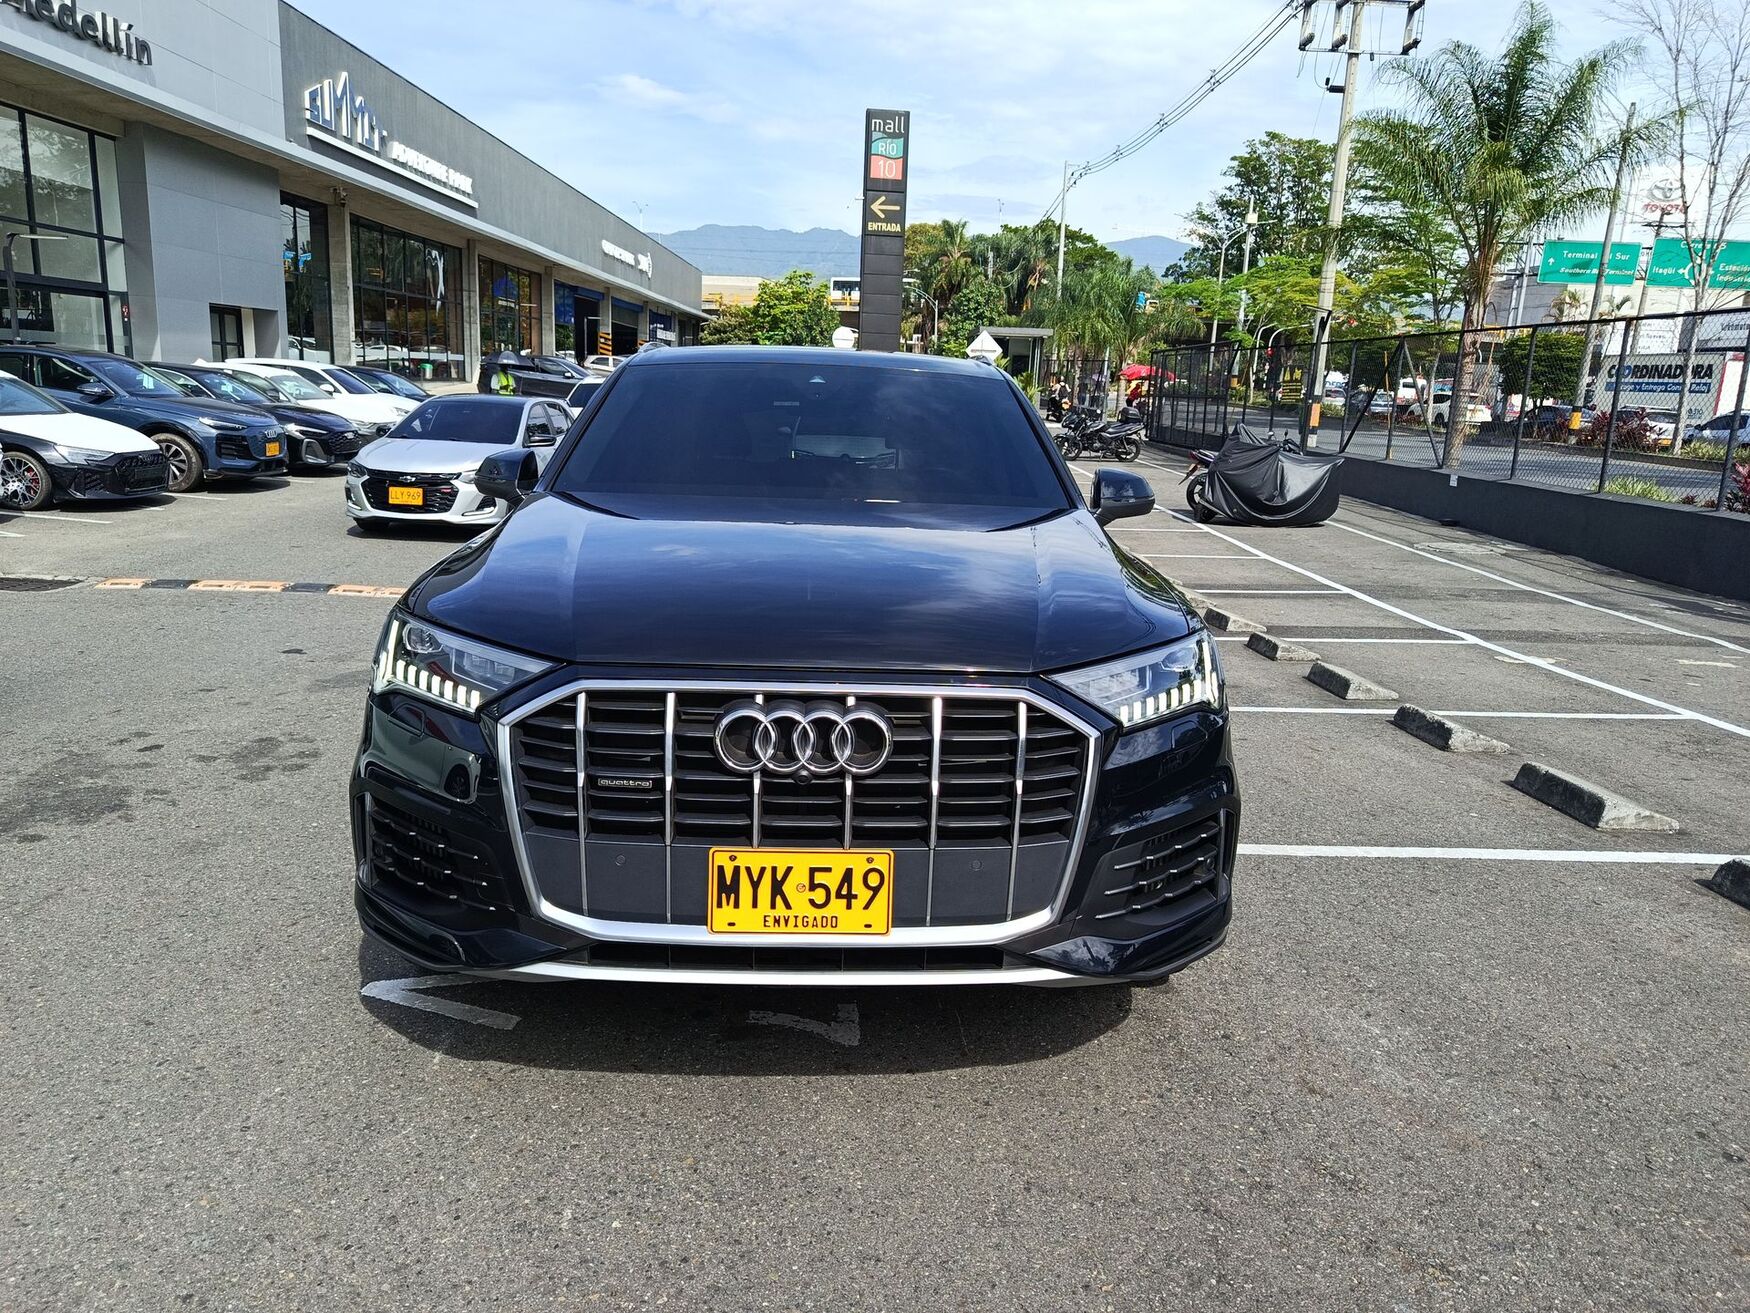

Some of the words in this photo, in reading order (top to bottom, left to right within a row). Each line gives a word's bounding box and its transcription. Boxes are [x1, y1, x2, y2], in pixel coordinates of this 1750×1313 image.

[871, 116, 905, 133] mall
[878, 140, 897, 155] RÍO
[879, 160, 896, 178] 10
[867, 222, 901, 233] ENTRADA
[1562, 250, 1598, 259] Terminal
[1615, 252, 1630, 260] Sur
[390, 490, 404, 499] LLY
[406, 491, 420, 500] 969
[600, 779, 650, 787] quattro
[716, 864, 794, 910] MYK
[807, 866, 886, 910] 549
[763, 914, 838, 928] ENVIGADO
